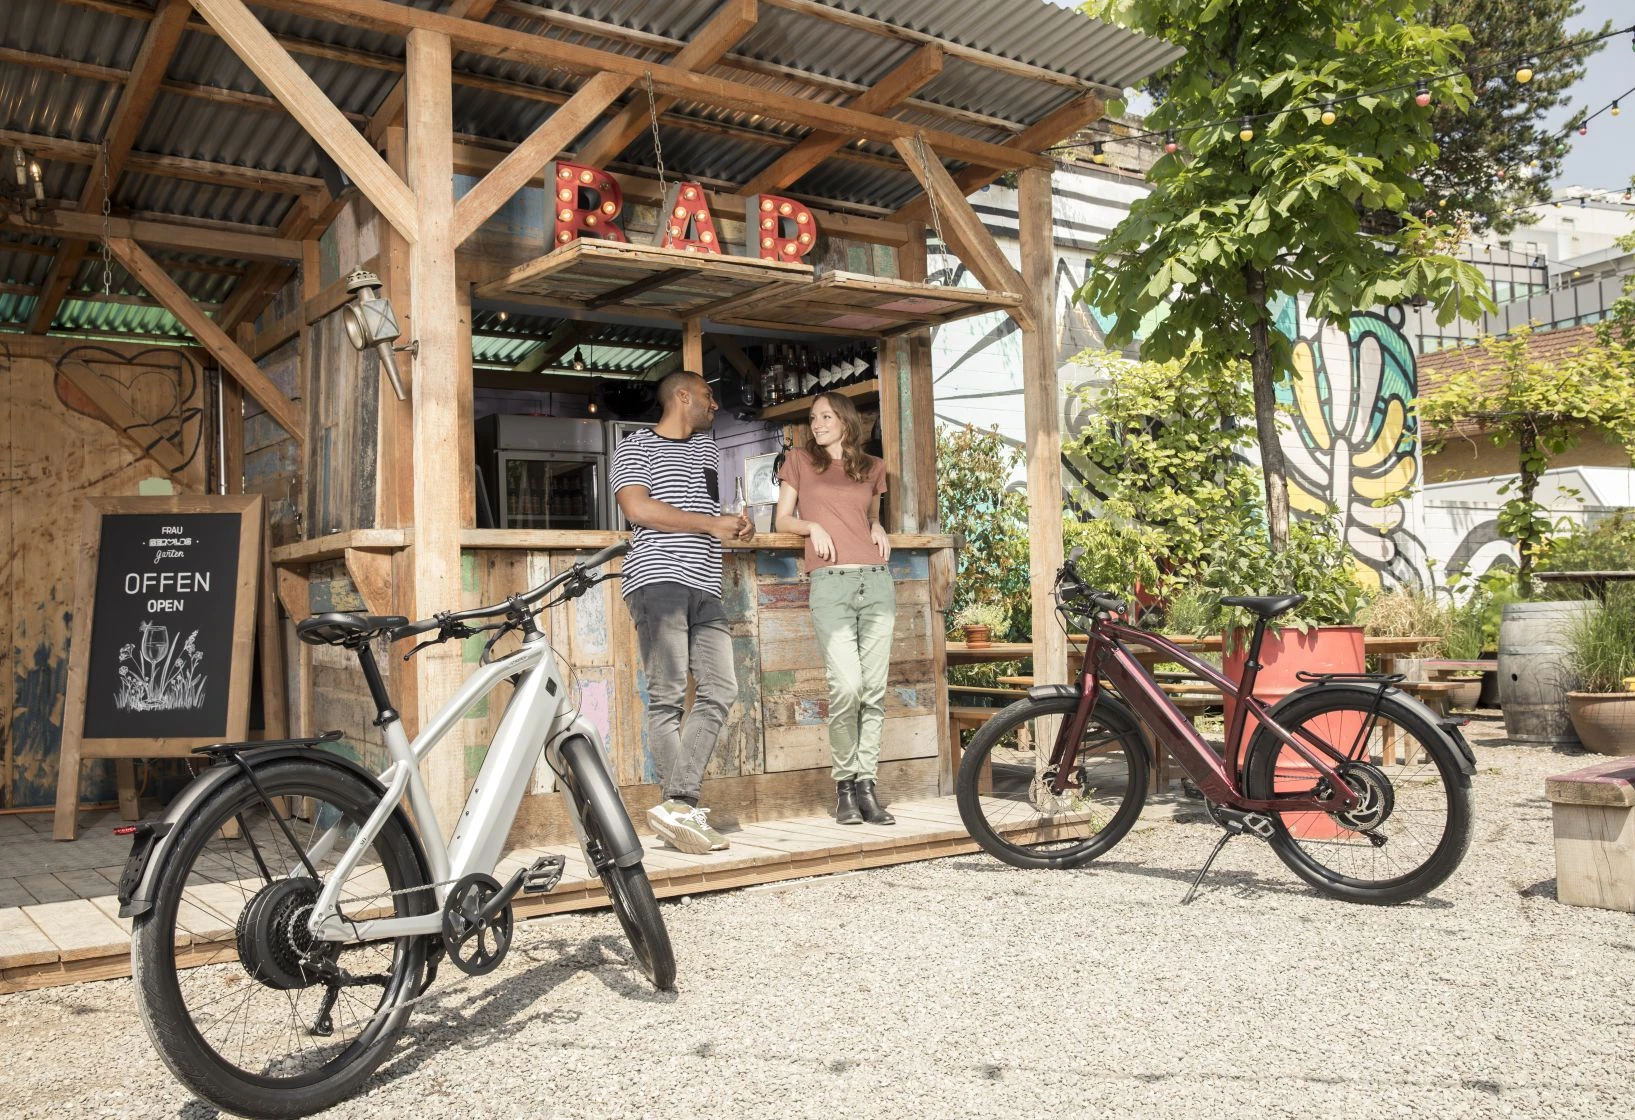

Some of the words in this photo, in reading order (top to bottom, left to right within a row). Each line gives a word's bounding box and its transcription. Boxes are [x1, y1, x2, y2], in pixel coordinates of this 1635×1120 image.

[546, 161, 818, 264] BAR
[162, 526, 183, 535] FRAU
[125, 571, 210, 595] OFFEN
[147, 599, 184, 613] OPEN
